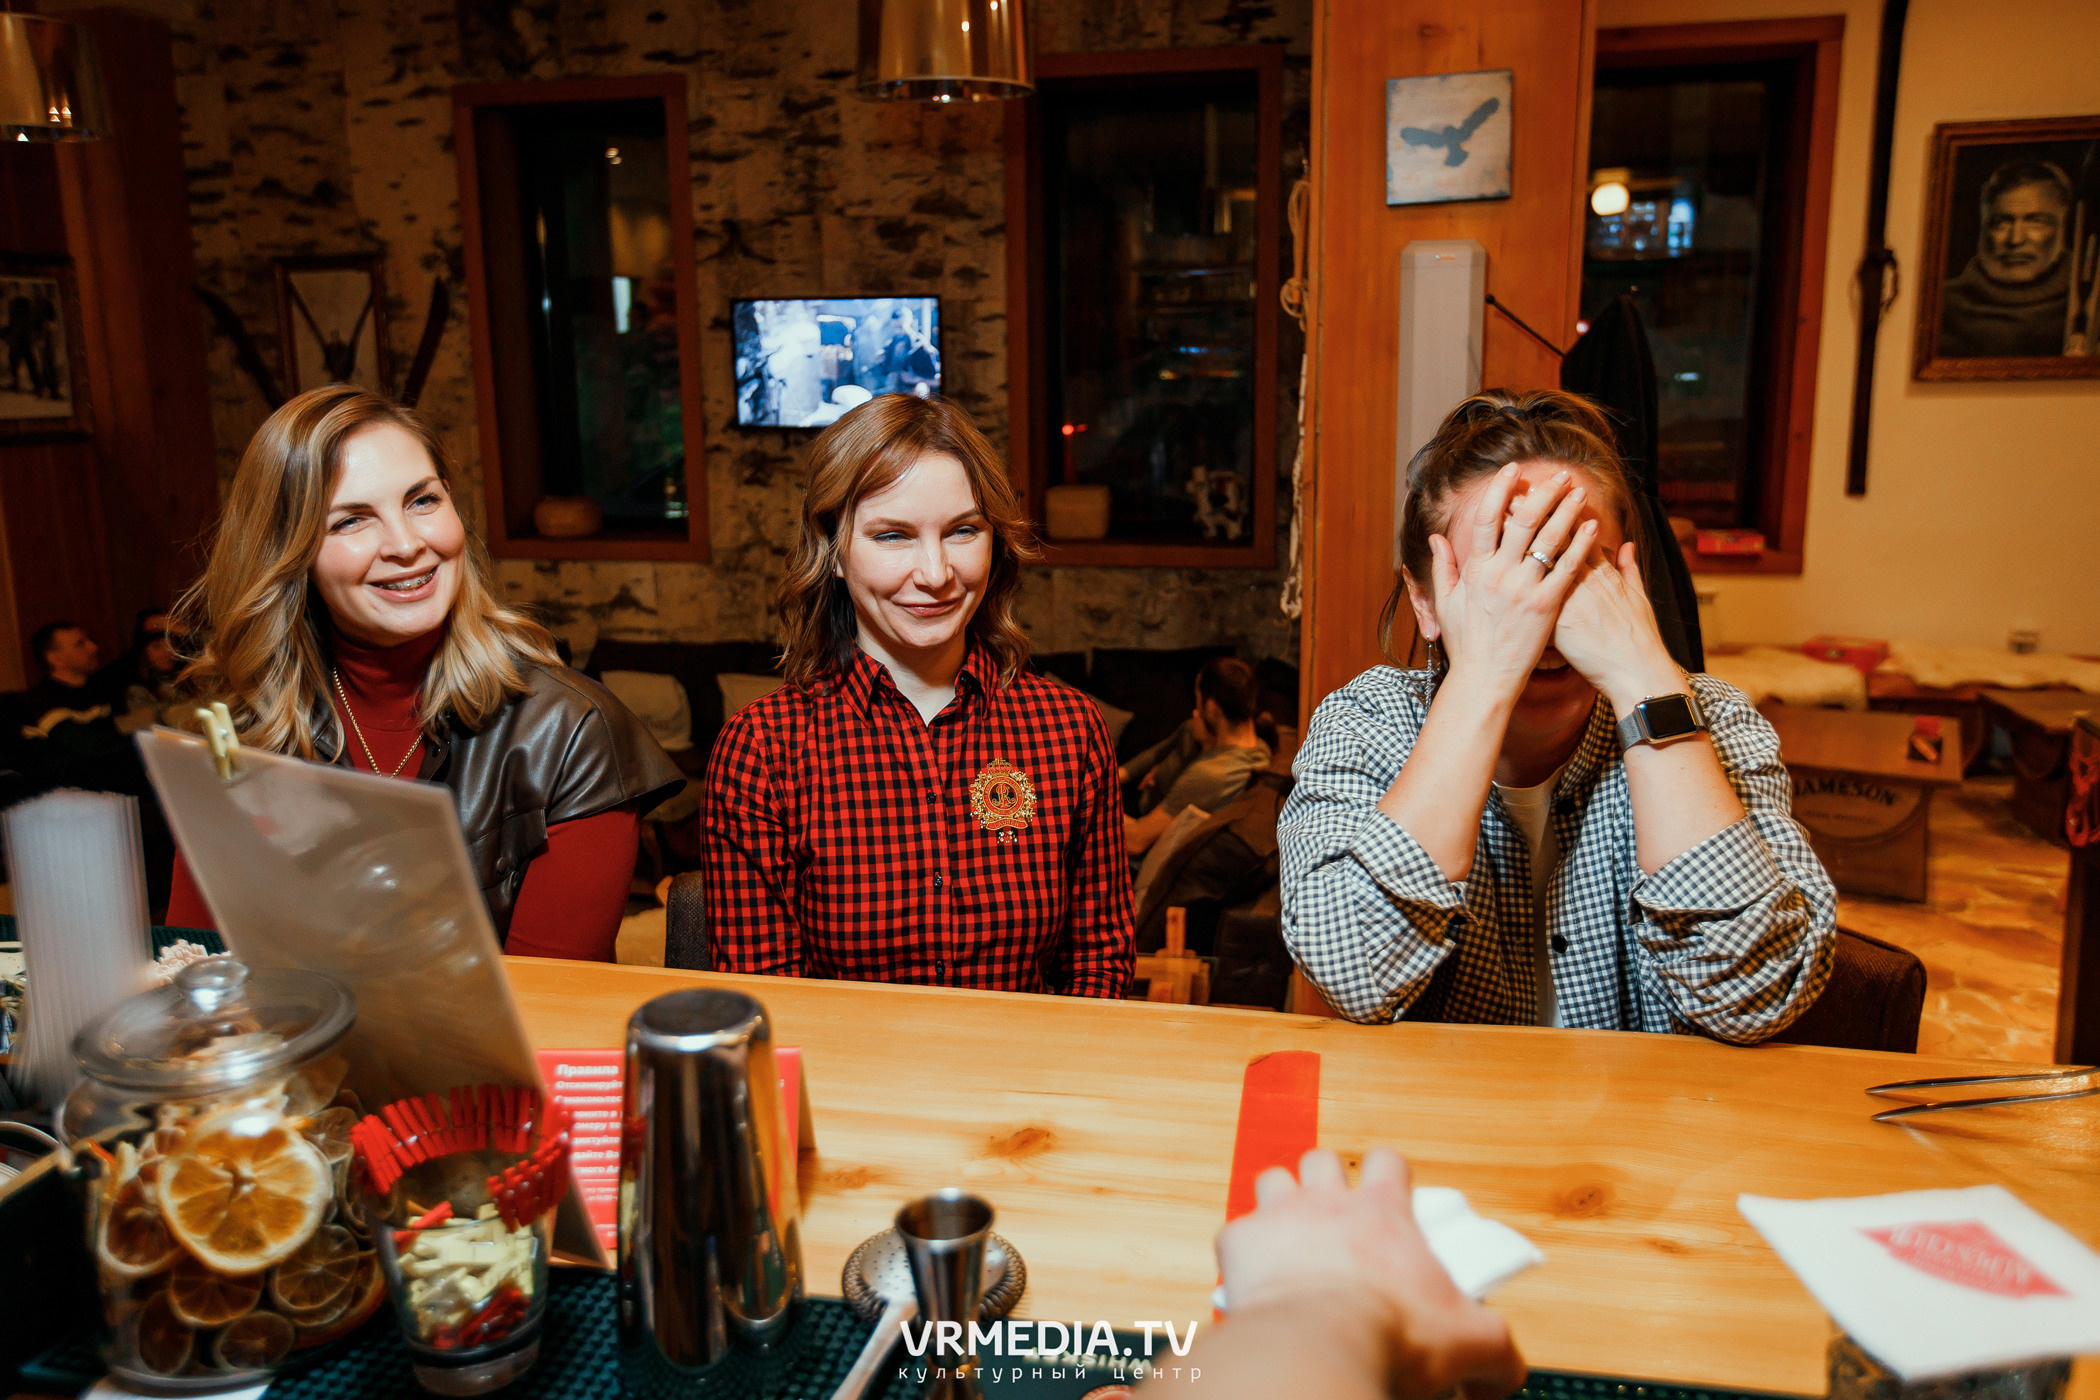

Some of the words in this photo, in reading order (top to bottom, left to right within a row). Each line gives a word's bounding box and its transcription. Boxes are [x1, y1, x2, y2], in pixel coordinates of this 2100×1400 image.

[1792, 778, 1897, 807] JAMESON
[993, 819, 1020, 829] LAUREN
[556, 1064, 619, 1077] Правила
[555, 1080, 623, 1091] Отсканируйт
[573, 1122, 607, 1131] омеру
[605, 1150, 620, 1158] Ва
